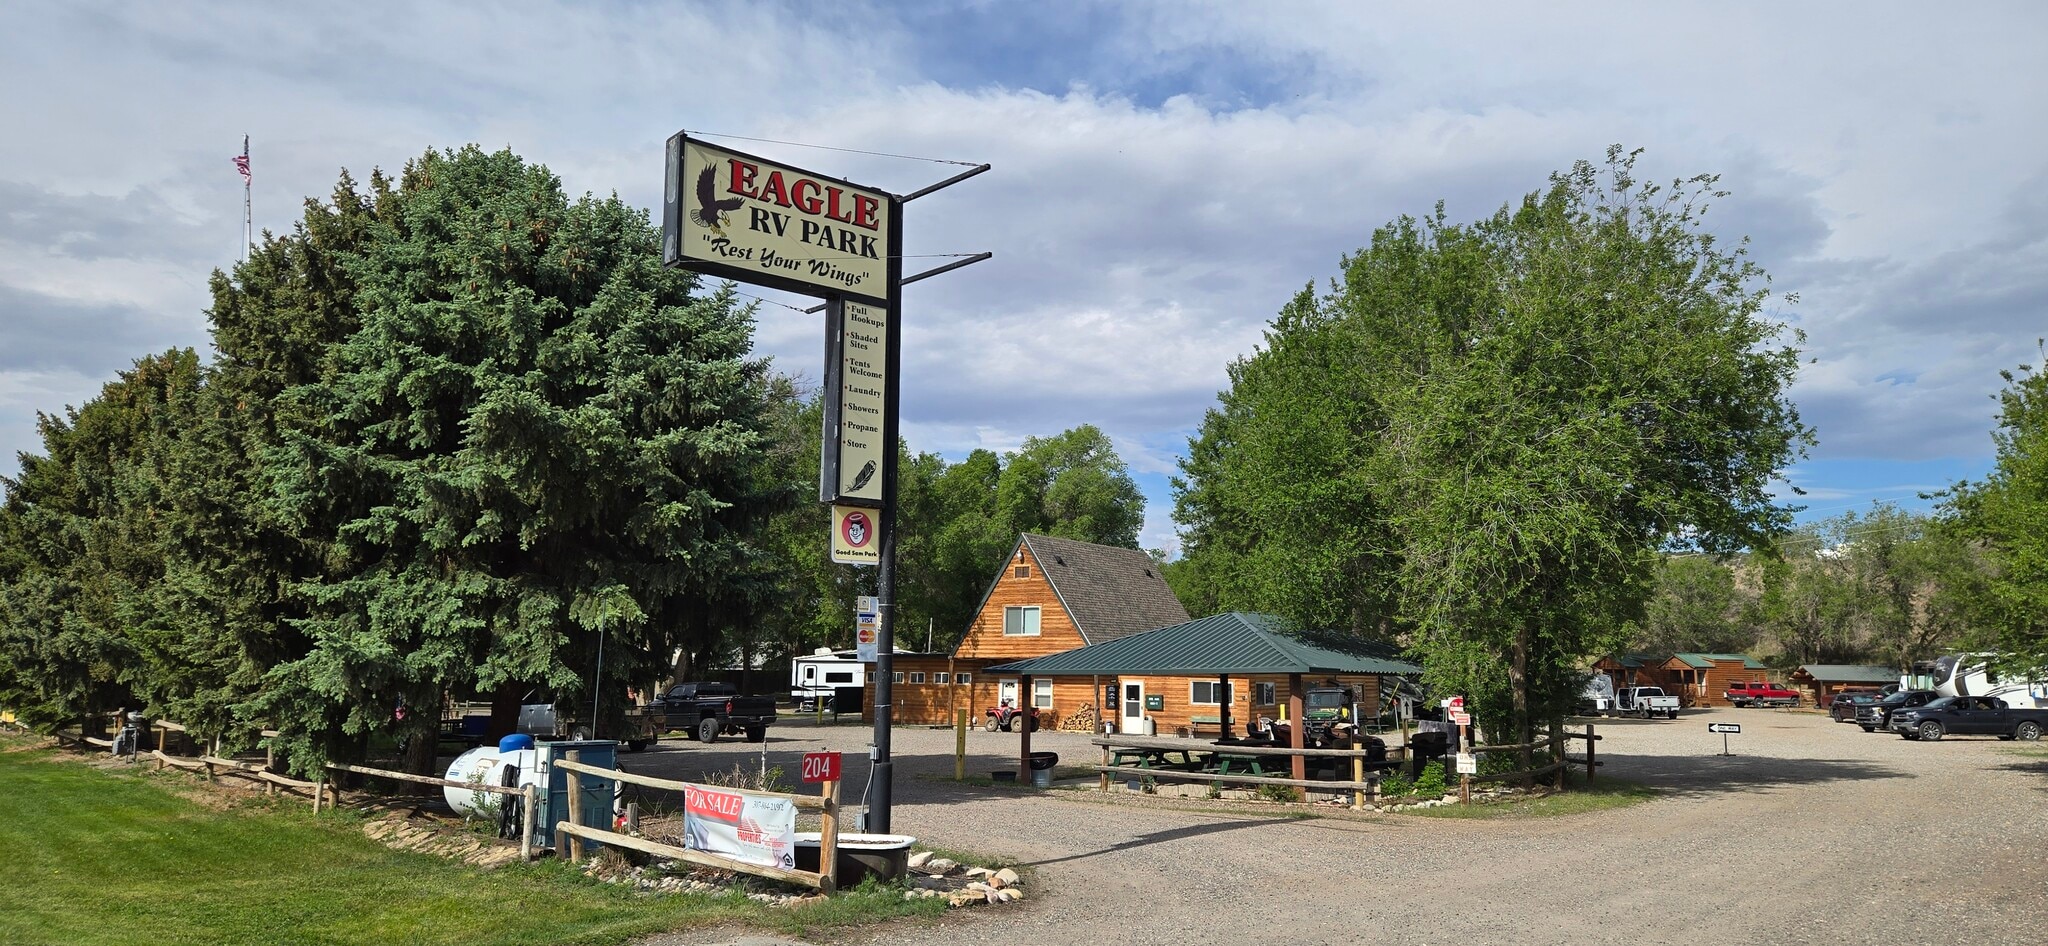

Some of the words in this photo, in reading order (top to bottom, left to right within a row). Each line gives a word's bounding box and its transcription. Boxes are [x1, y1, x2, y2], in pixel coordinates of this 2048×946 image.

[727, 158, 879, 231] EAGLE
[749, 206, 791, 237] RV
[800, 218, 880, 260] PARK
[702, 234, 752, 260] "Rest
[759, 247, 801, 271] Your
[807, 258, 869, 286] Wings"
[851, 305, 867, 316] Full
[851, 313, 885, 328] Hookups
[850, 331, 878, 344] Shaded
[850, 340, 868, 350] Sites
[850, 358, 870, 368] Tents
[849, 366, 883, 380] Welcome
[848, 384, 882, 399] Laundry
[847, 402, 879, 415] Showers
[847, 421, 878, 433] Propane
[847, 438, 867, 449] Store
[804, 757, 830, 779] 204
[684, 788, 707, 810] FOR
[707, 793, 741, 816] SALE
[737, 830, 762, 845] PROPERTIES
